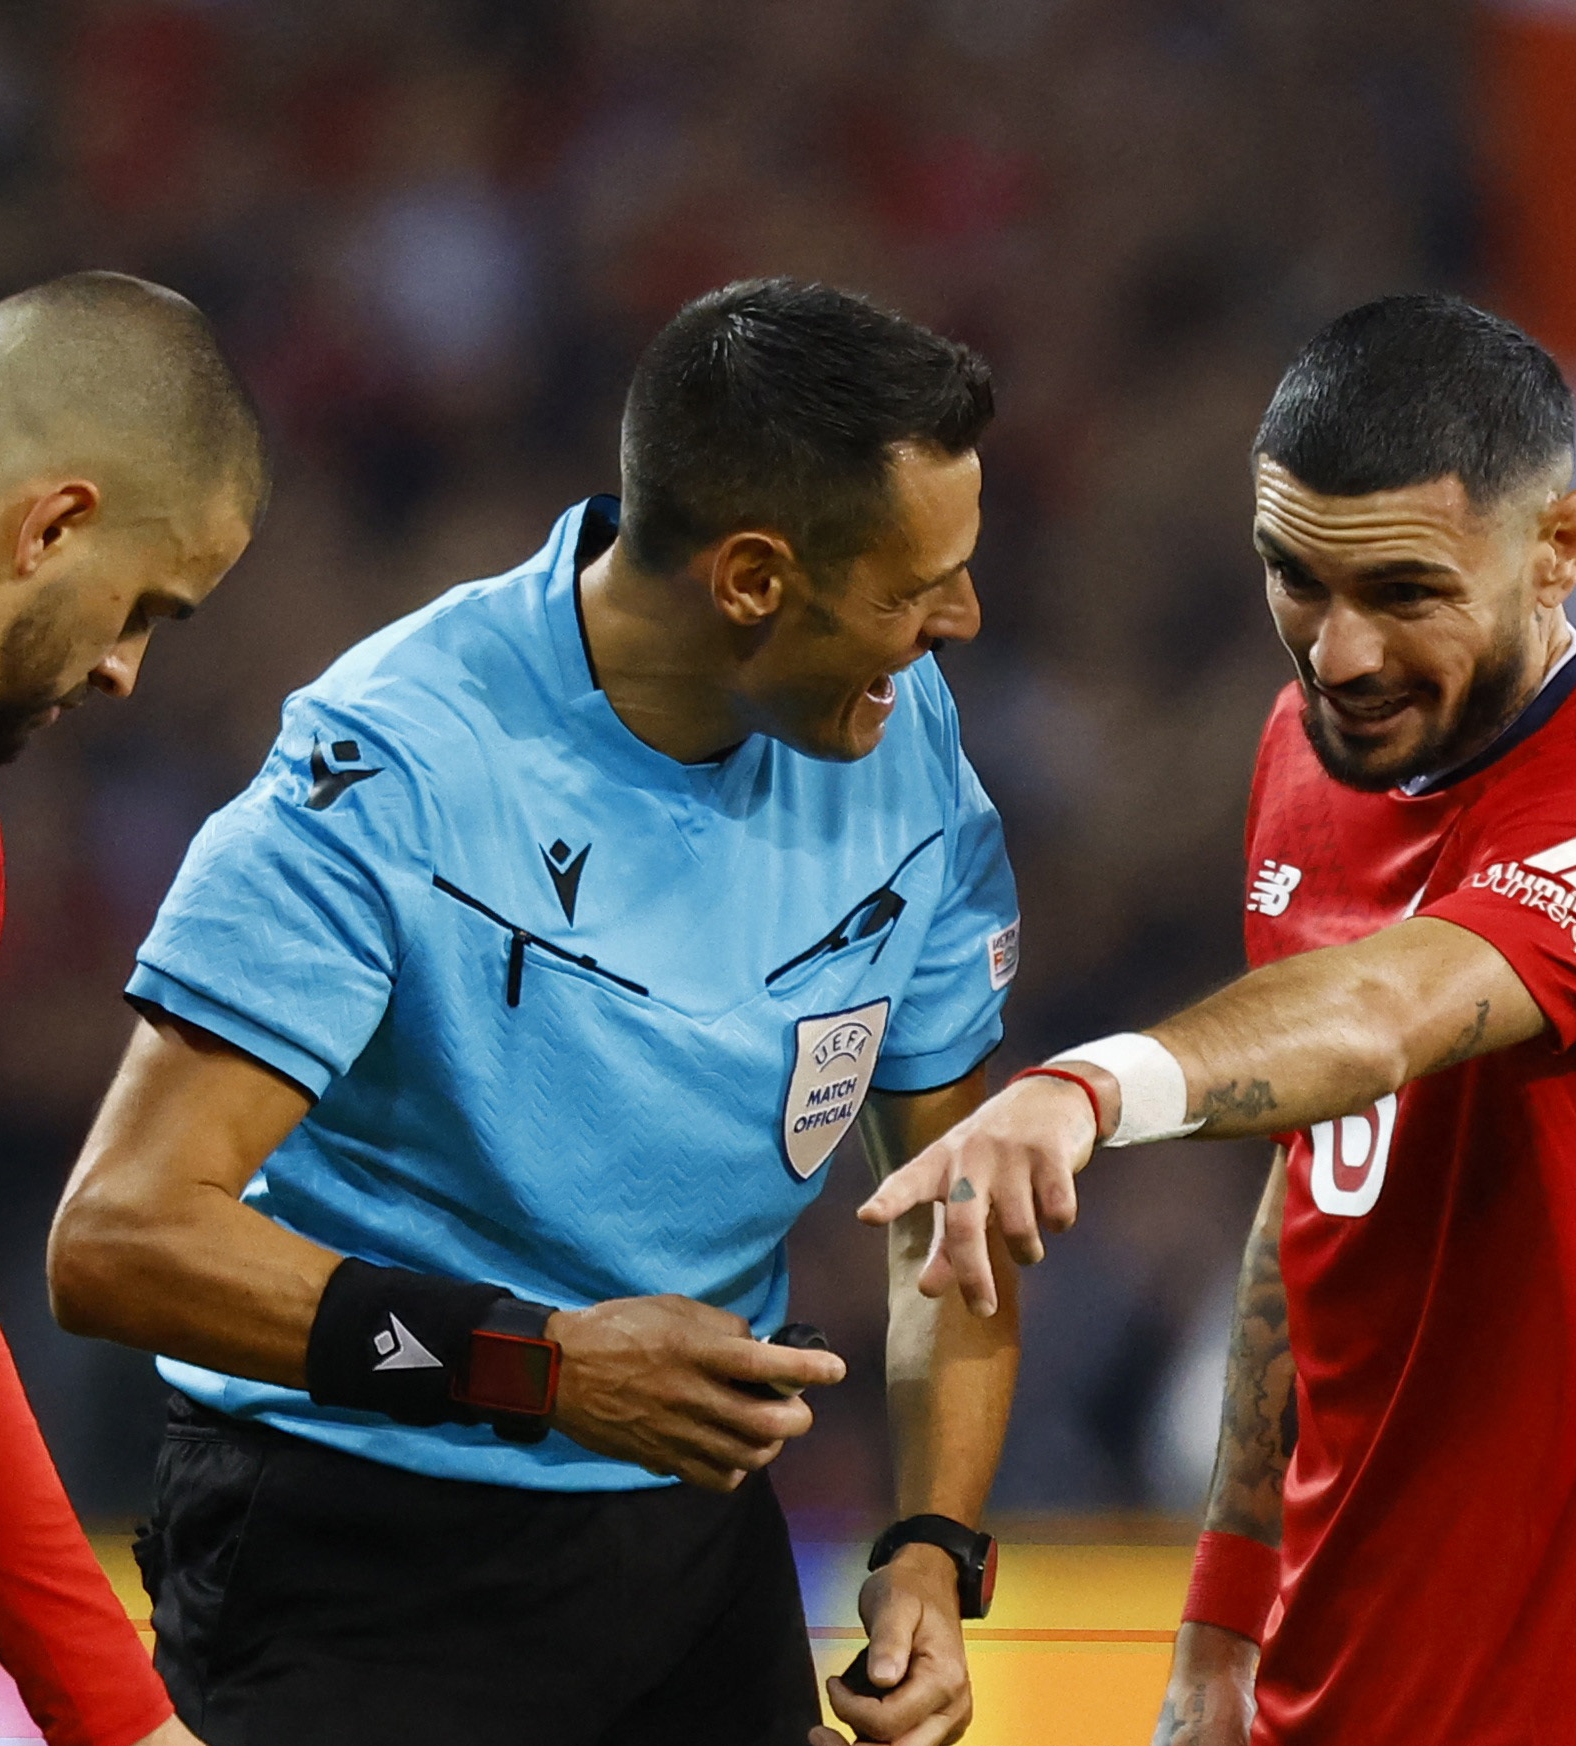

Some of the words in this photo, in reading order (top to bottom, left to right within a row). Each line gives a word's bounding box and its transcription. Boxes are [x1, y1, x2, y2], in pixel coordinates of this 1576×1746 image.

[814, 1028, 868, 1065] UEFA
[805, 1077, 858, 1107] MATCH
[793, 1101, 854, 1134] OFFICIAL
